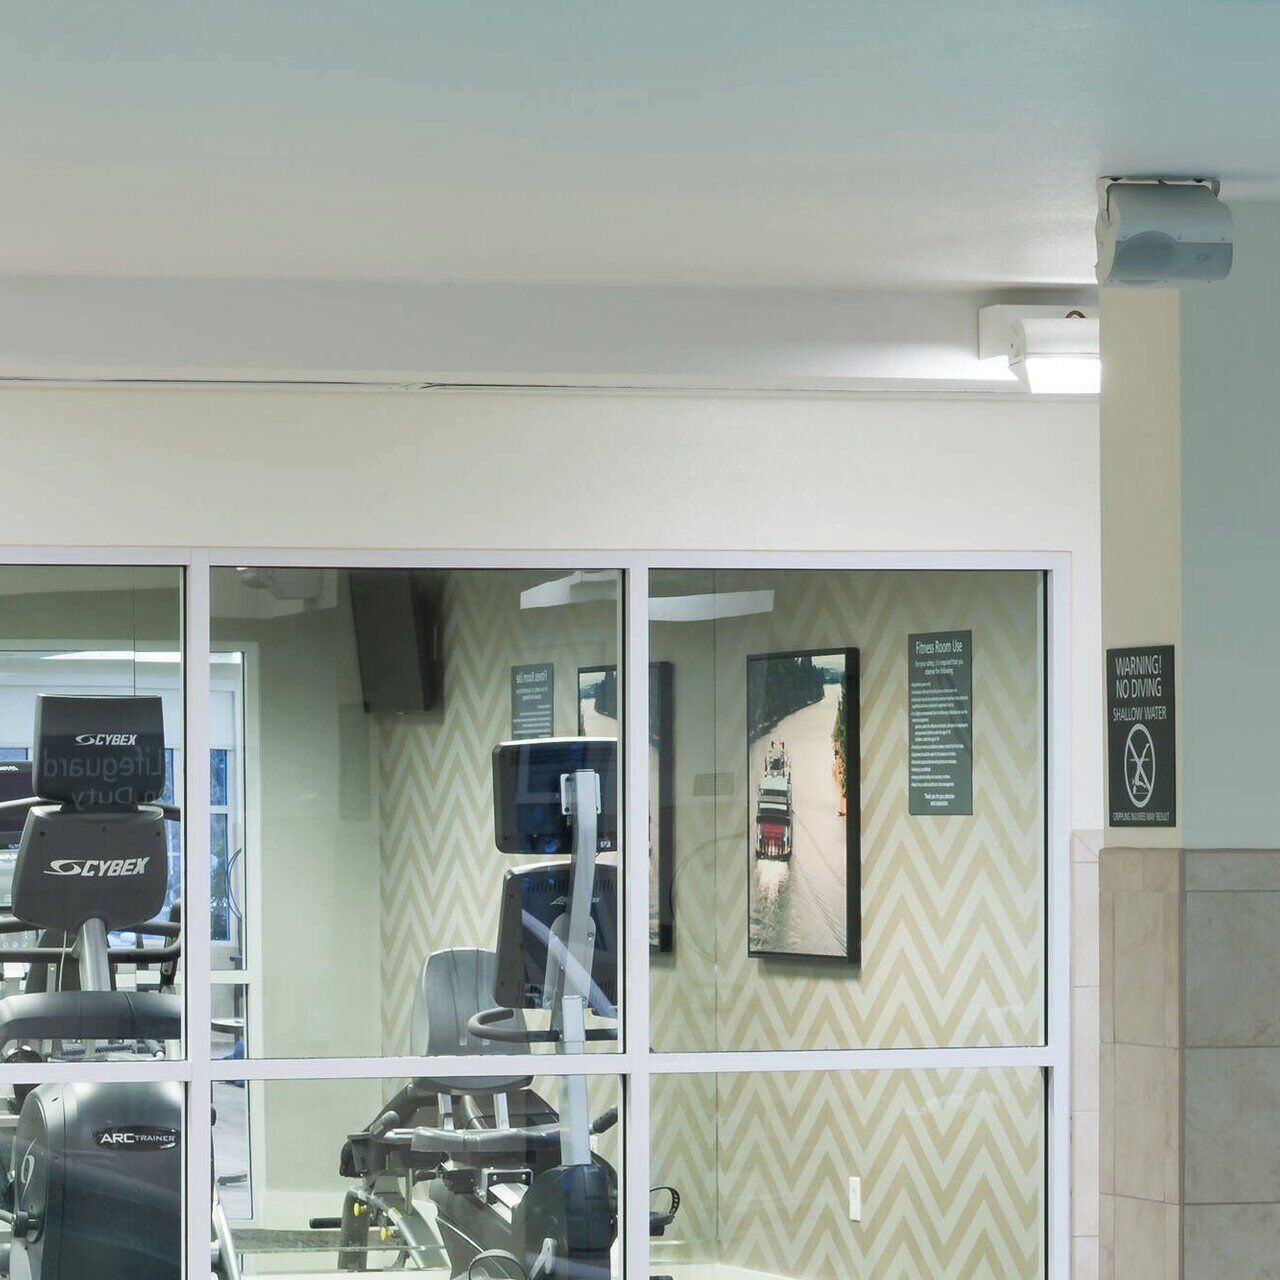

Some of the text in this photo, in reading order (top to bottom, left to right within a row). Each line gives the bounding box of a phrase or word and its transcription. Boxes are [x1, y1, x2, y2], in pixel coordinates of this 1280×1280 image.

[916, 640, 962, 654] Fitness Room Use
[1116, 655, 1162, 676] WARNING!
[1116, 678, 1162, 698] NO DIVING
[1113, 706, 1167, 721] SHALLOW WATER
[95, 734, 137, 746] CYBEX
[81, 857, 150, 876] CYBEX
[100, 1133, 135, 1143] ARC
